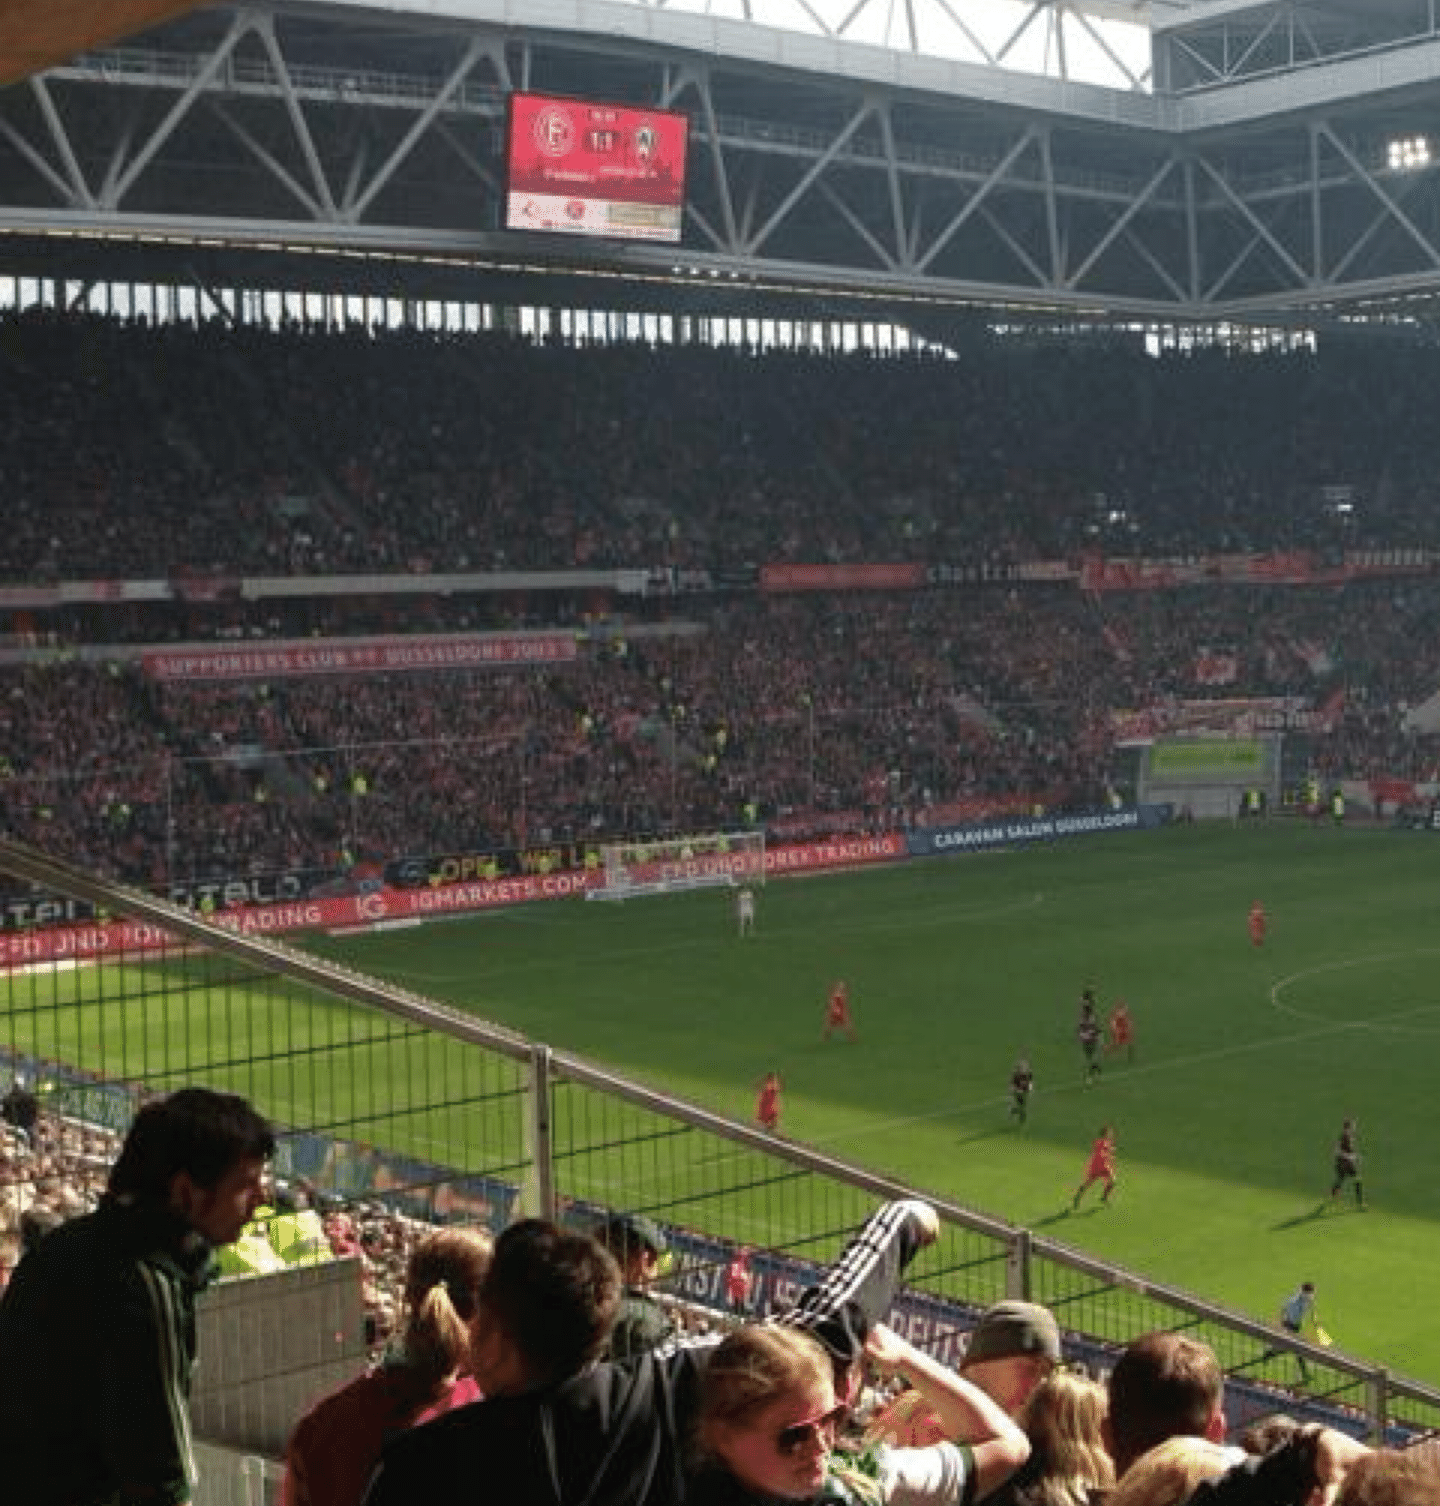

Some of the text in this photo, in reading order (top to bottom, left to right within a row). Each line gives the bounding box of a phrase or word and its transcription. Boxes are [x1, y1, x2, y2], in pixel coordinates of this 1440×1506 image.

[935, 828, 1004, 848] CARAVAN
[410, 875, 587, 911] IGMARKETS.COM
[815, 838, 895, 863] TRADING
